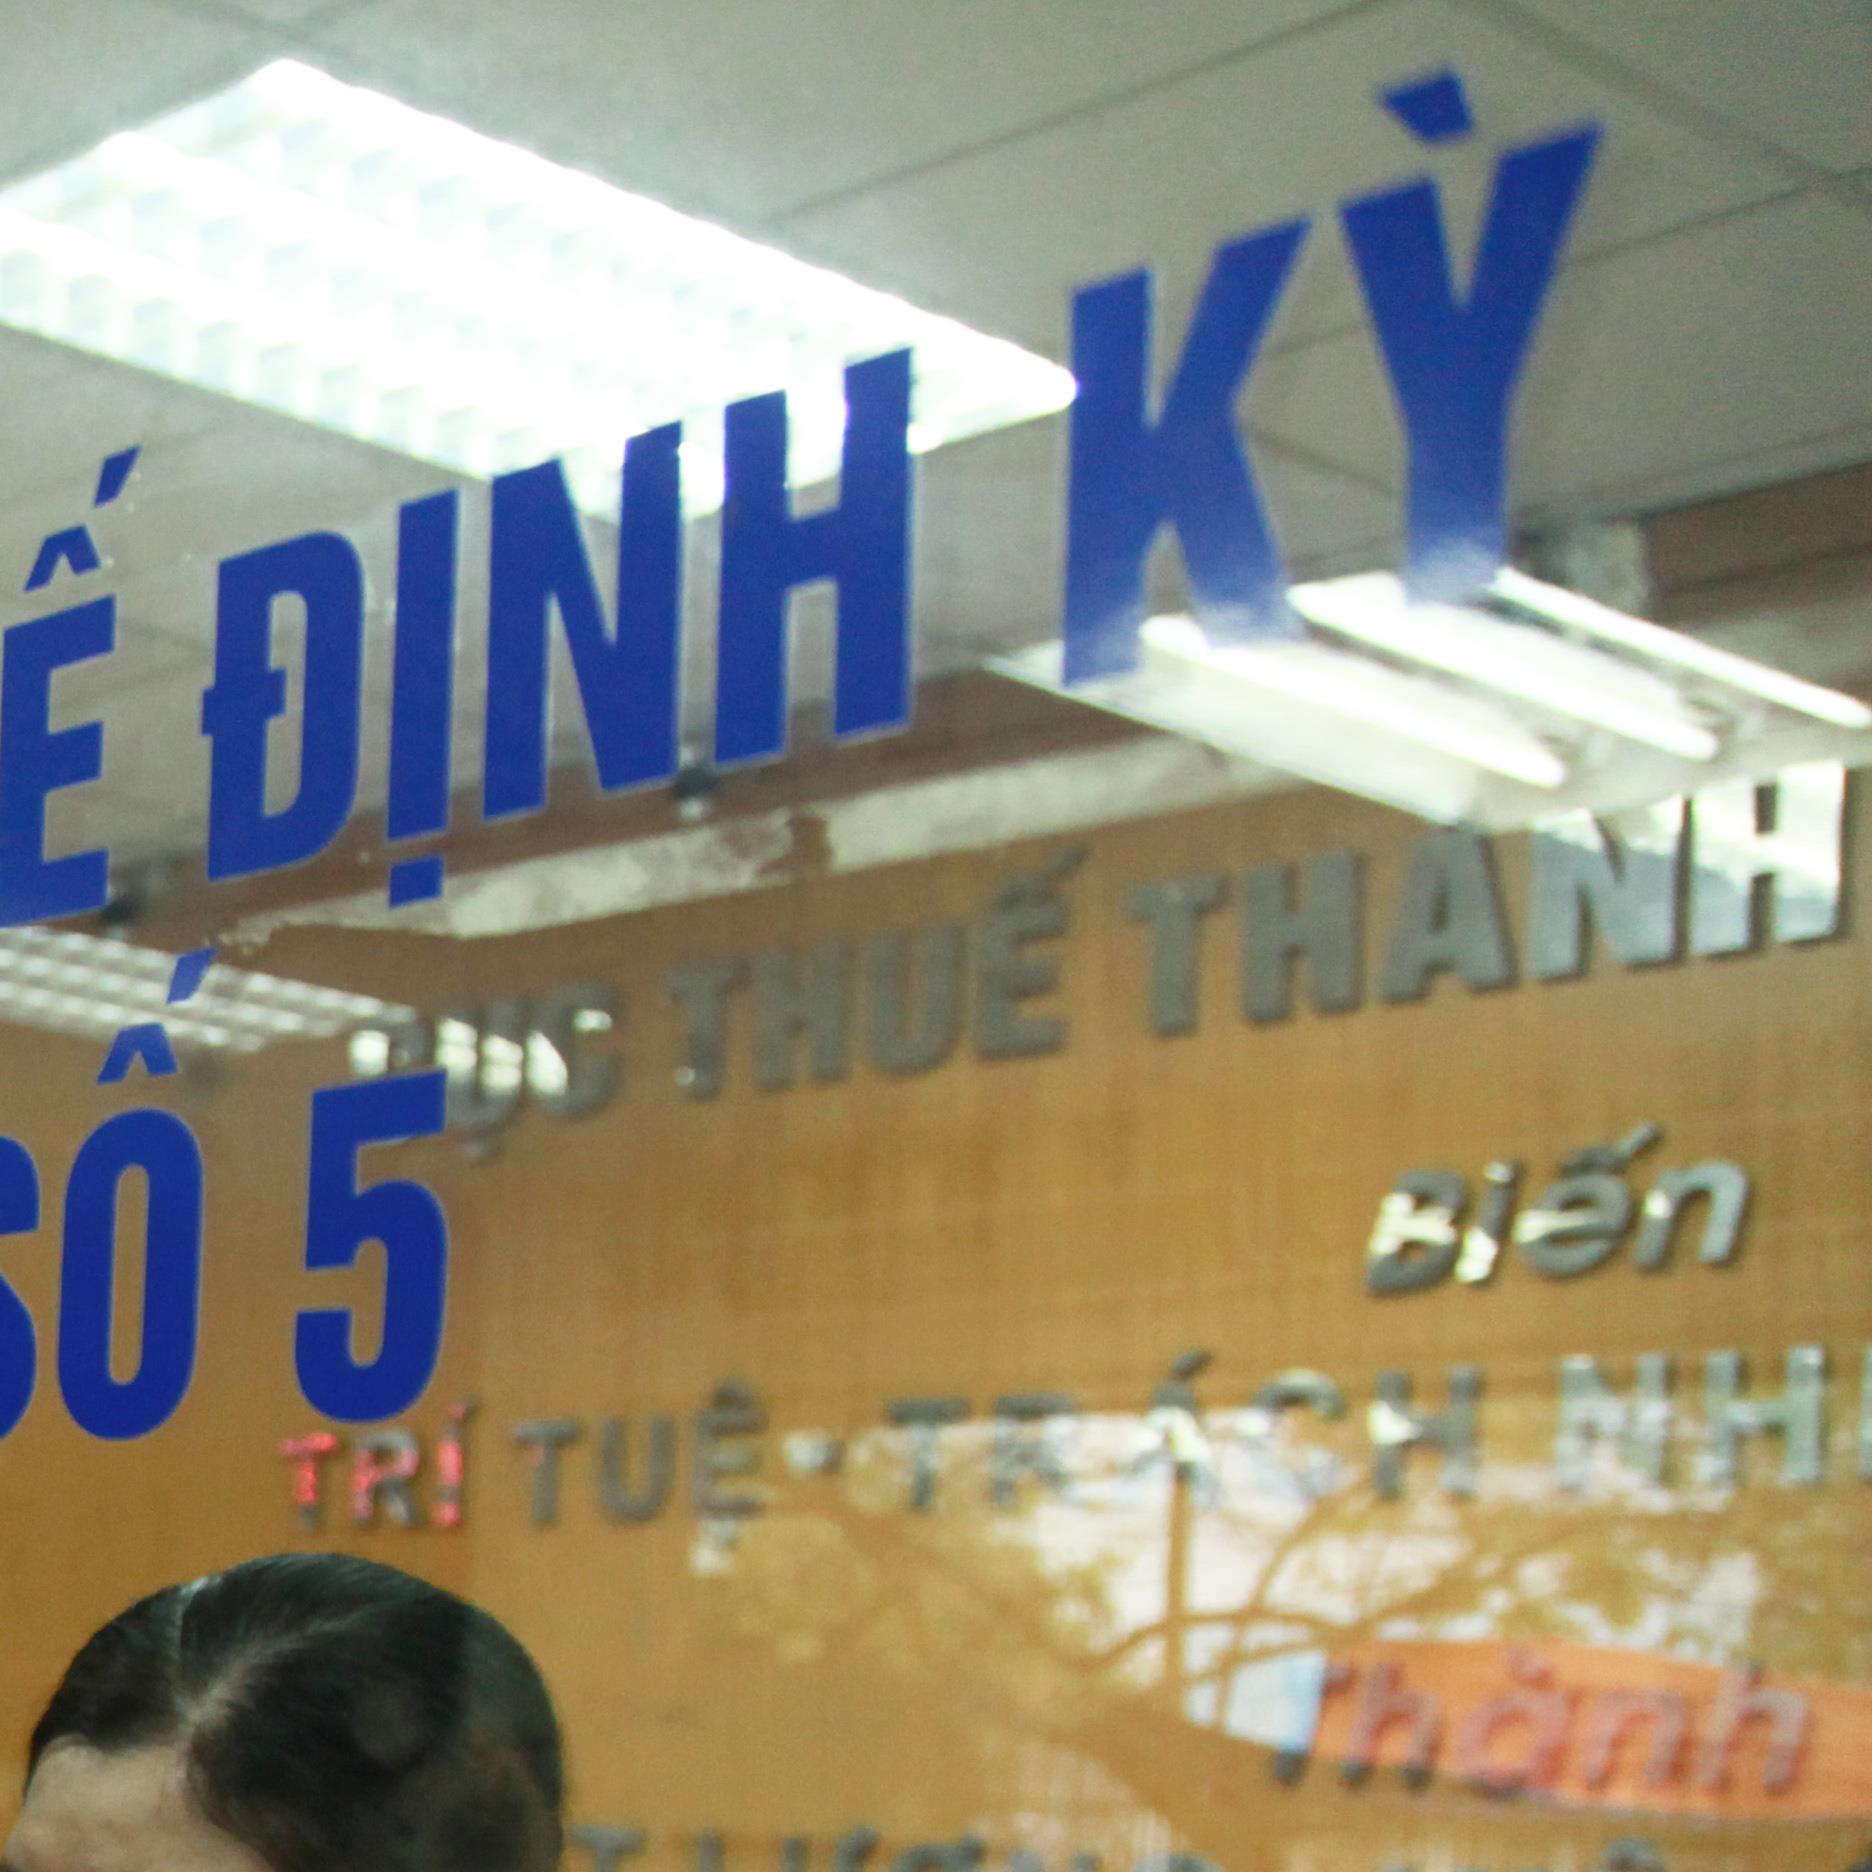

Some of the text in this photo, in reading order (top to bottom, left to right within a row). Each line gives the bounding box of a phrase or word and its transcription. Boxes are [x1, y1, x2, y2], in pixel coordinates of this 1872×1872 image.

[201, 349, 913, 906] ĐỊNH
[1063, 73, 1600, 684] KỲ
[663, 838, 1086, 1100] THUẾ
[296, 1072, 446, 1421] 5
[279, 1396, 478, 1532] TRÍ
